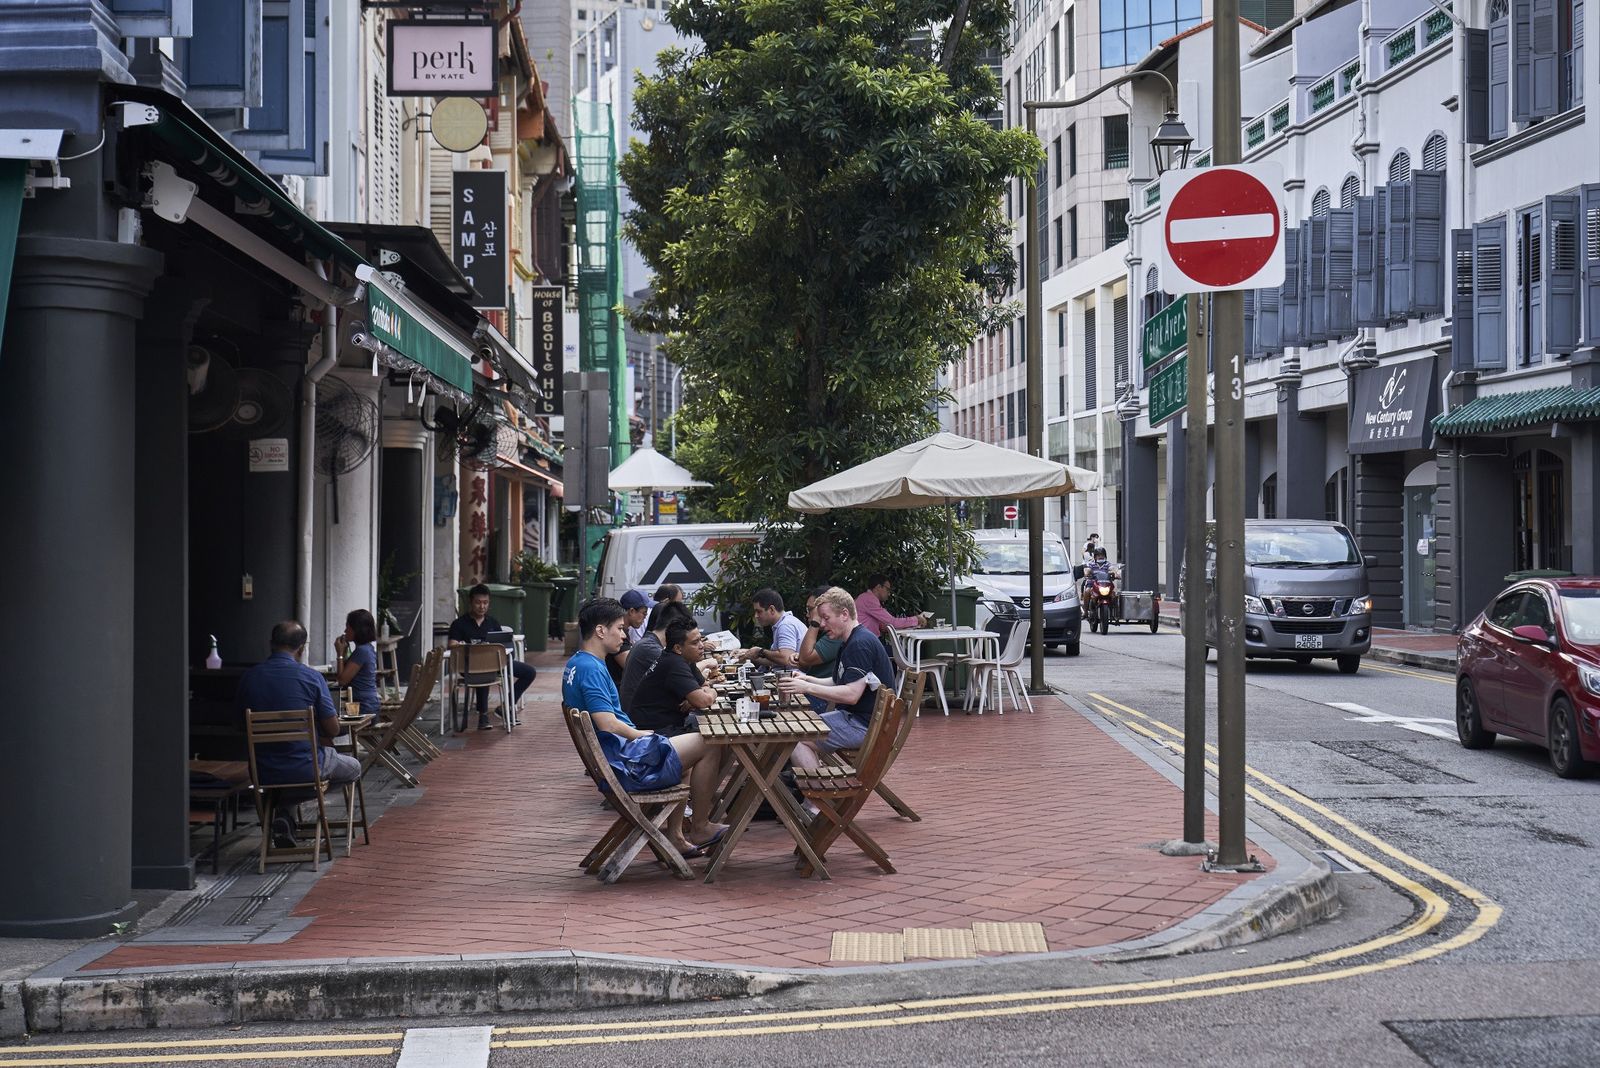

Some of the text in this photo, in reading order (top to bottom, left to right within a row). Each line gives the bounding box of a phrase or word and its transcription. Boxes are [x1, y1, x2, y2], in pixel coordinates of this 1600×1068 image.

[411, 41, 477, 79] perk
[481, 221, 497, 257] 삼포
[1145, 318, 1164, 355] Telok
[1164, 312, 1181, 347] Ayer
[1365, 408, 1413, 425] New Century Group
